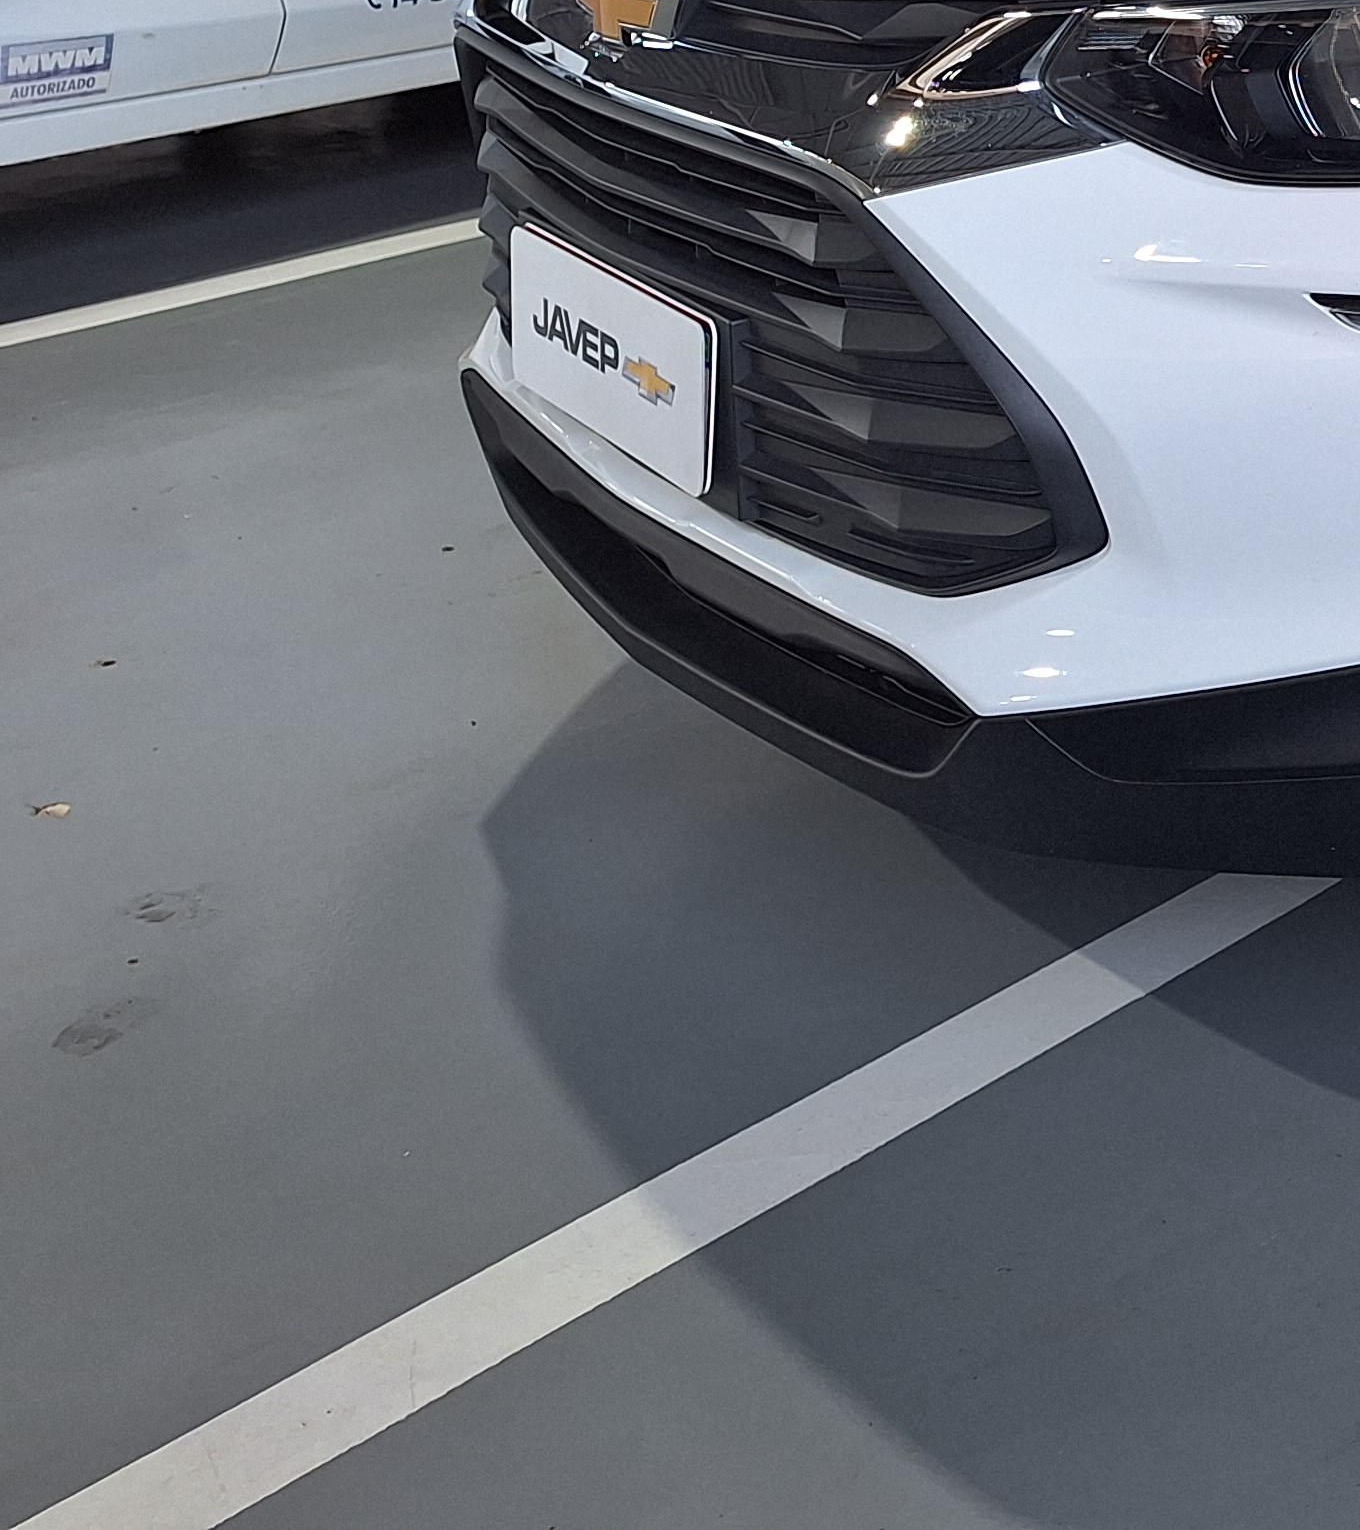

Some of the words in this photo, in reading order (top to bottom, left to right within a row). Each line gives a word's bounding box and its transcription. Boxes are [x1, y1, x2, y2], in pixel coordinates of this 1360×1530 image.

[7, 46, 105, 77] MWM
[10, 76, 96, 100] AUTORIZADO
[533, 297, 619, 374] JAVEP
